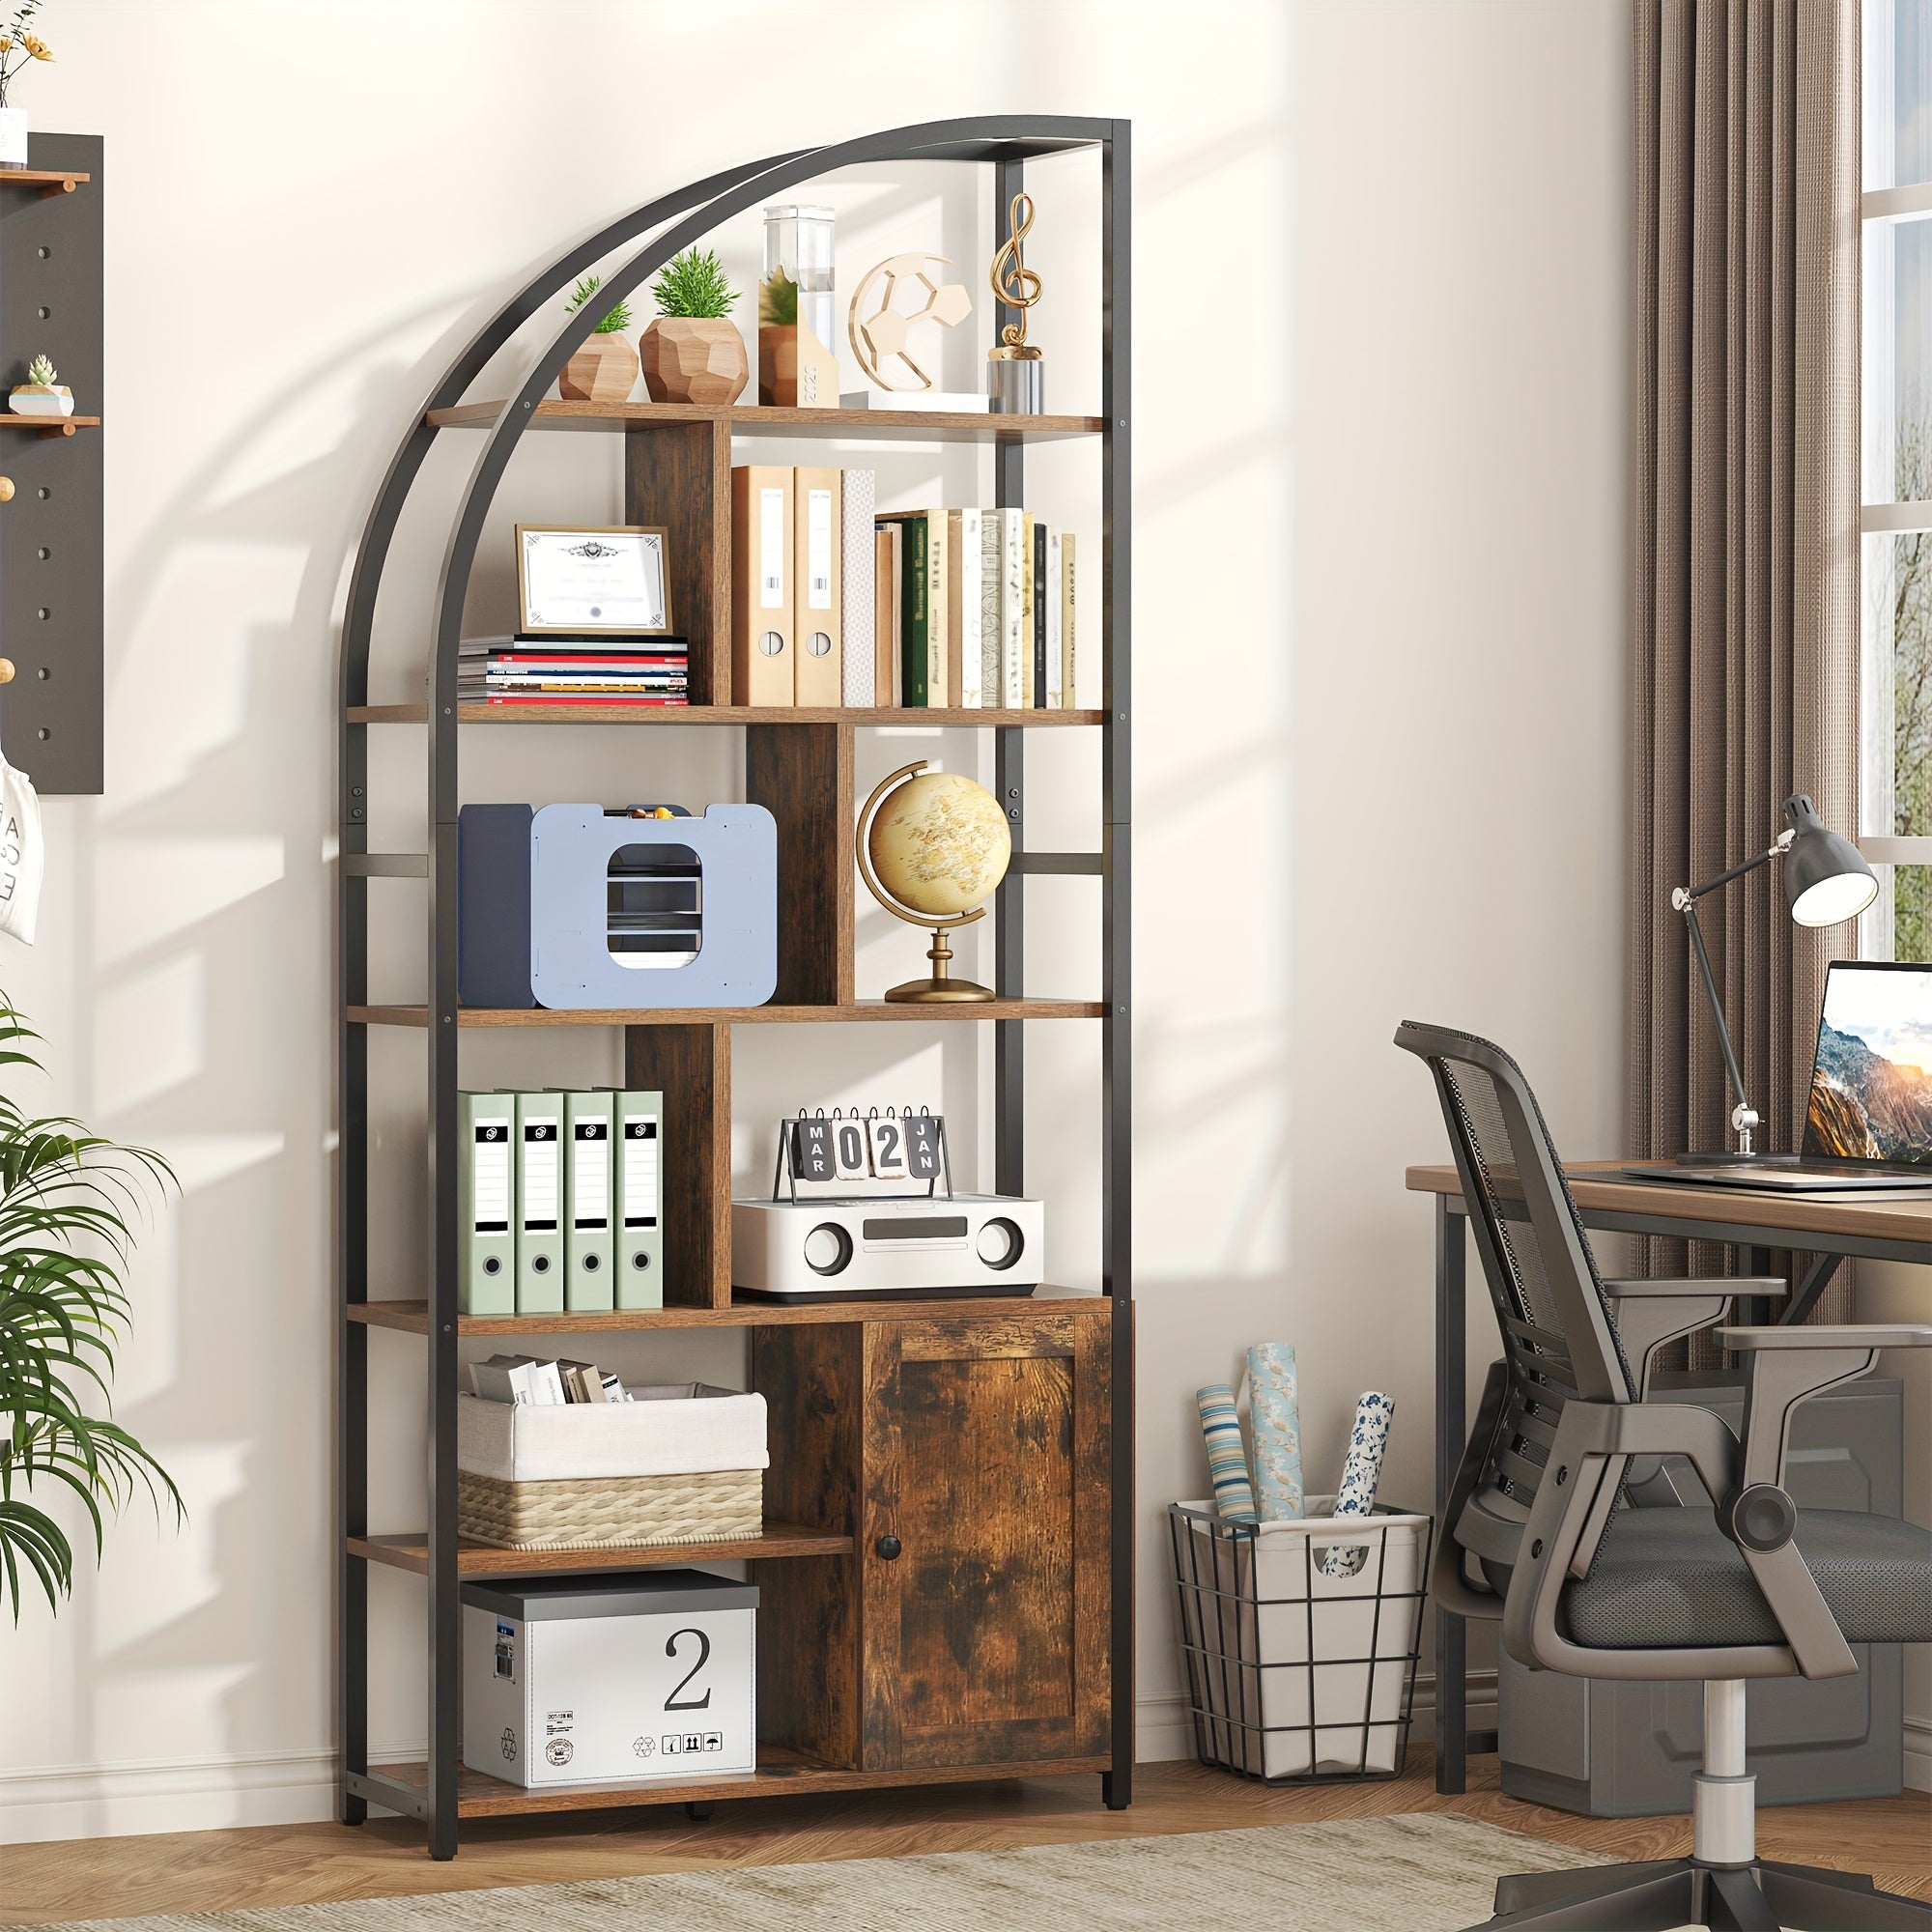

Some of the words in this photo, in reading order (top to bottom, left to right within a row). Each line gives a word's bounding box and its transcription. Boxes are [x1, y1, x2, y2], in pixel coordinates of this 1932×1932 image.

[810, 1126, 825, 1172] MAR
[916, 1123, 933, 1169] JAN
[665, 1628, 711, 1712] 2
